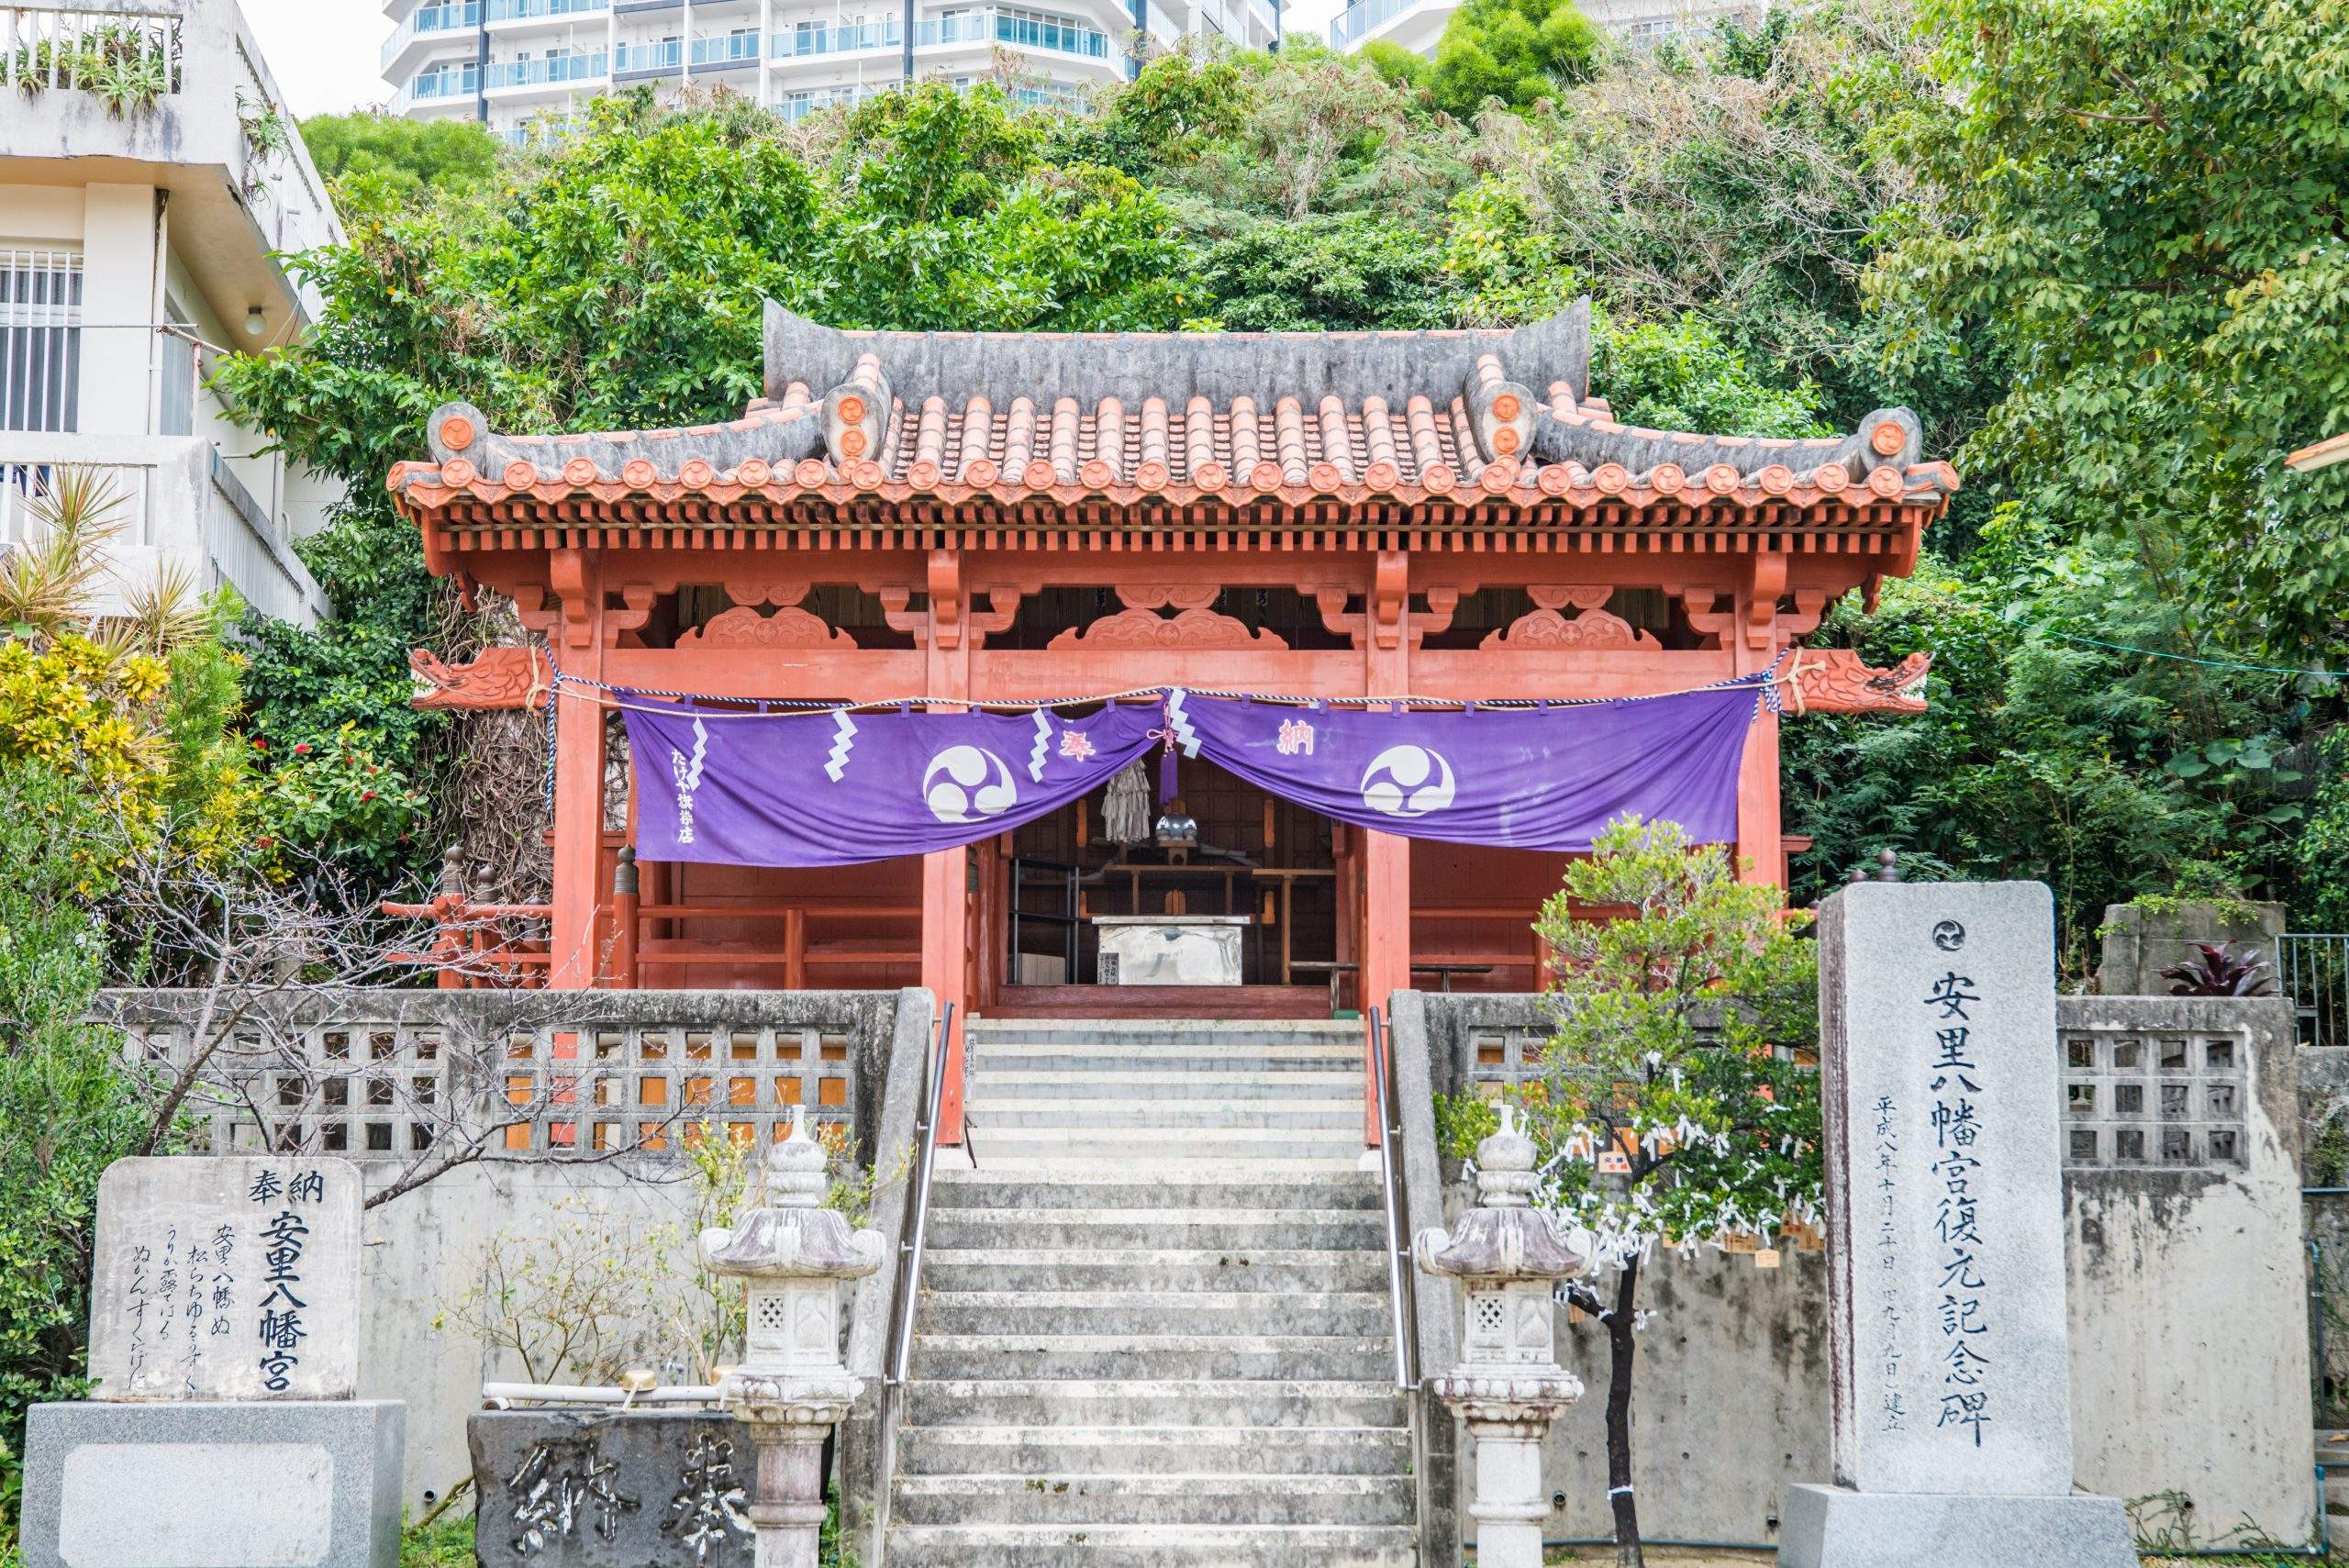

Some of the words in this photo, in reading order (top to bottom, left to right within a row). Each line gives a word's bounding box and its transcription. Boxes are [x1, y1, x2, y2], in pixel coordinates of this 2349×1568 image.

[1275, 718, 1314, 755] 納
[249, 1170, 325, 1205] 奉納
[1924, 971, 1991, 1448] 安里八幡宮復元記念碑
[259, 1211, 309, 1391] 安里八幡宮
